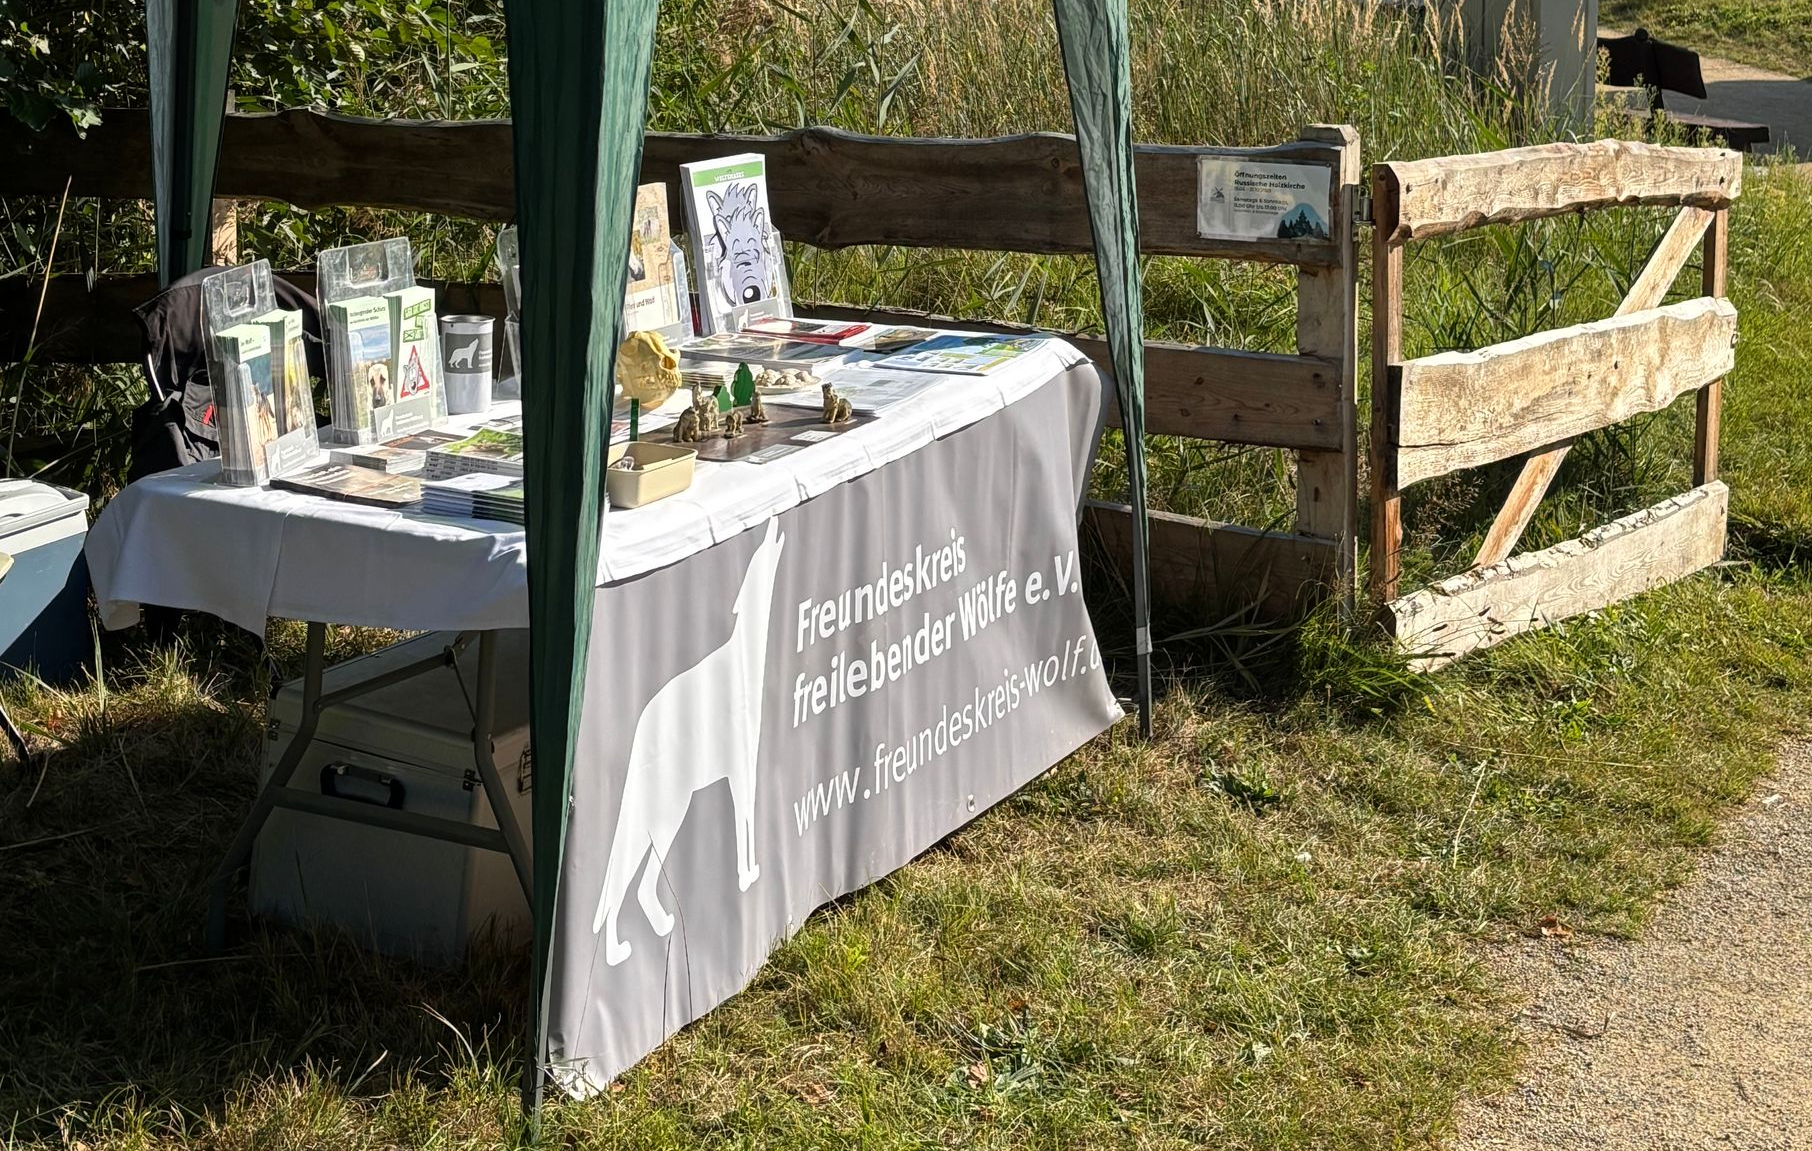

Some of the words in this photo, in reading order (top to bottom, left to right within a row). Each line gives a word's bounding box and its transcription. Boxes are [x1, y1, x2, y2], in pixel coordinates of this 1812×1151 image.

[1234, 170, 1287, 180] Öffnungszeiten
[1234, 180, 1268, 188] Russische
[1269, 182, 1305, 190] Holzkirche
[796, 527, 967, 654] Freundeskreis
[793, 612, 956, 729] freilebender
[958, 570, 1017, 642] Wölfe
[1025, 571, 1050, 605] e.
[1054, 550, 1078, 596] V.
